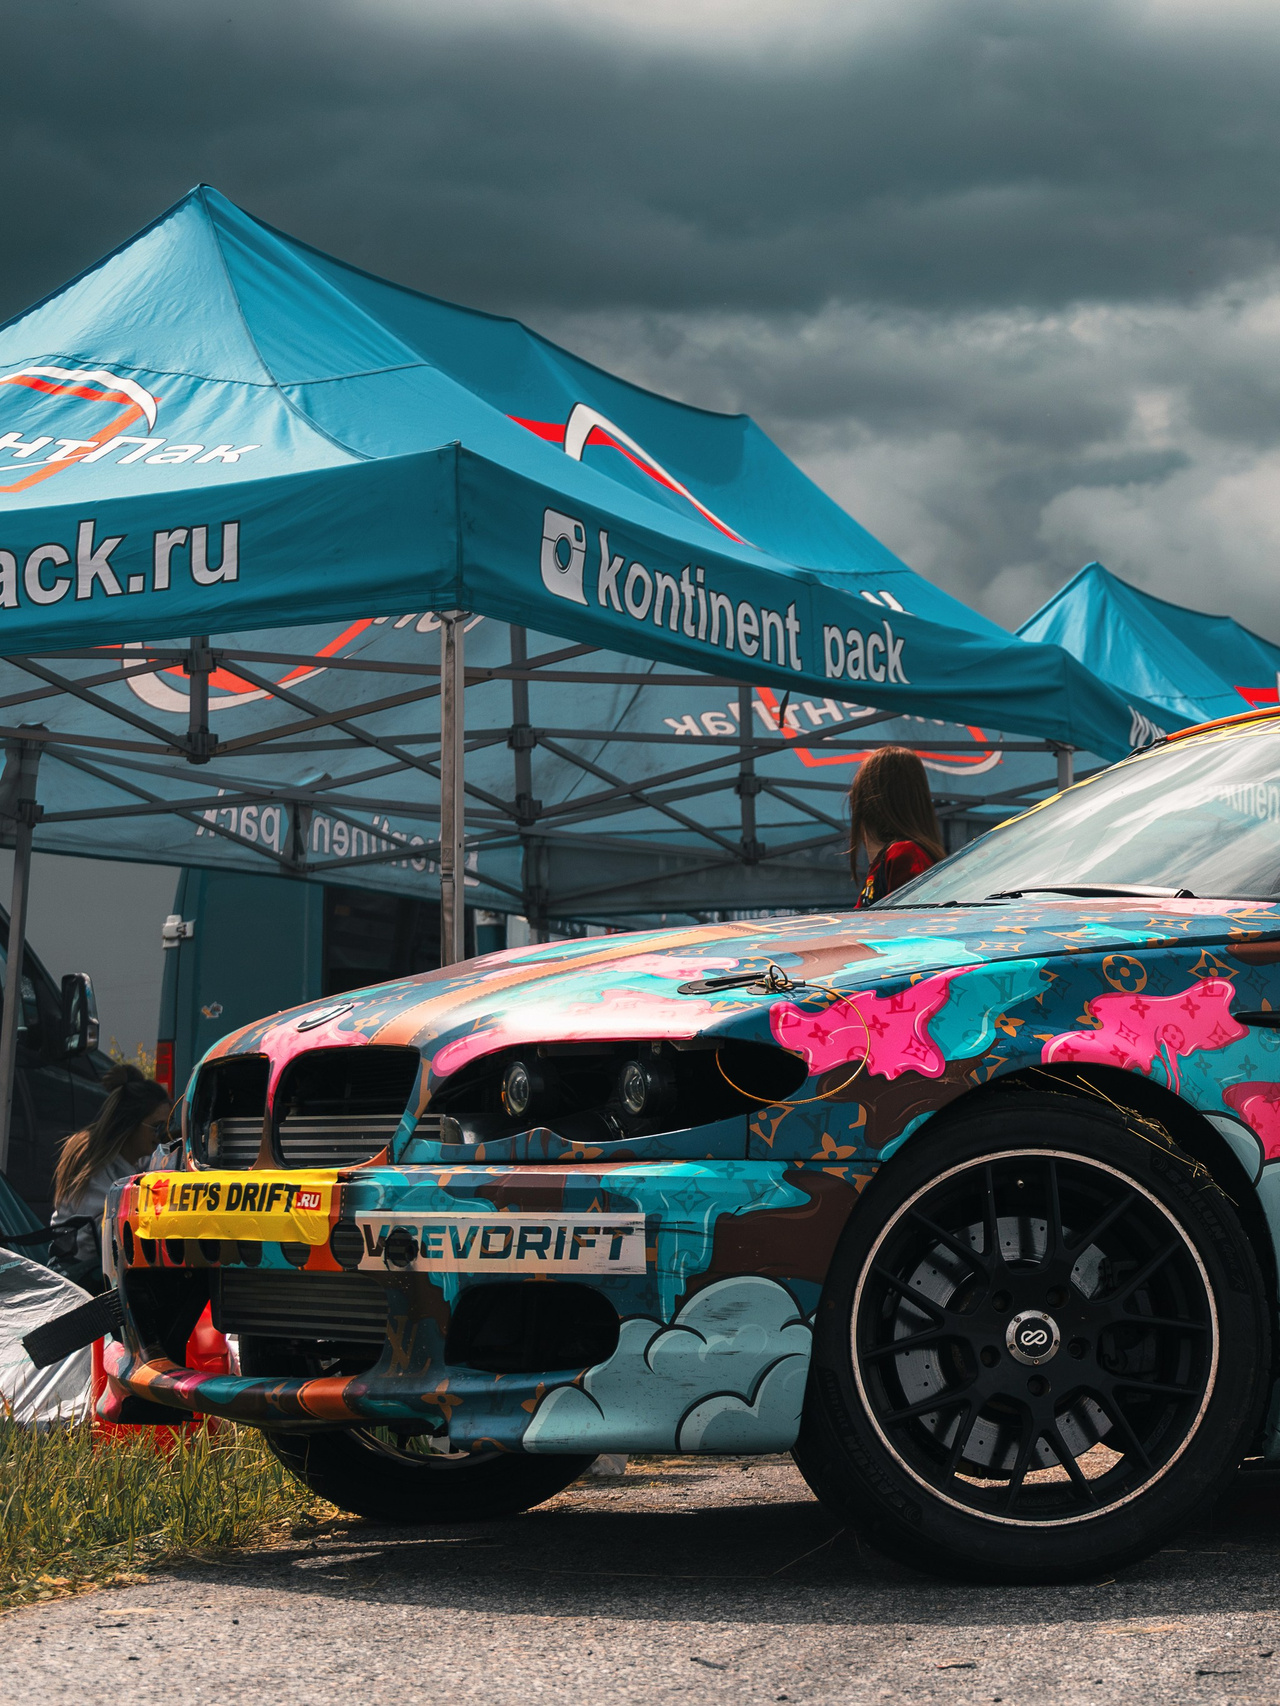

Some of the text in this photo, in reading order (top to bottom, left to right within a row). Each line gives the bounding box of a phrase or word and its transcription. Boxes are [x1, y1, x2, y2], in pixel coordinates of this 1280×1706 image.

[598, 529, 912, 686] kontinent pack
[168, 1182, 221, 1213] LET'S
